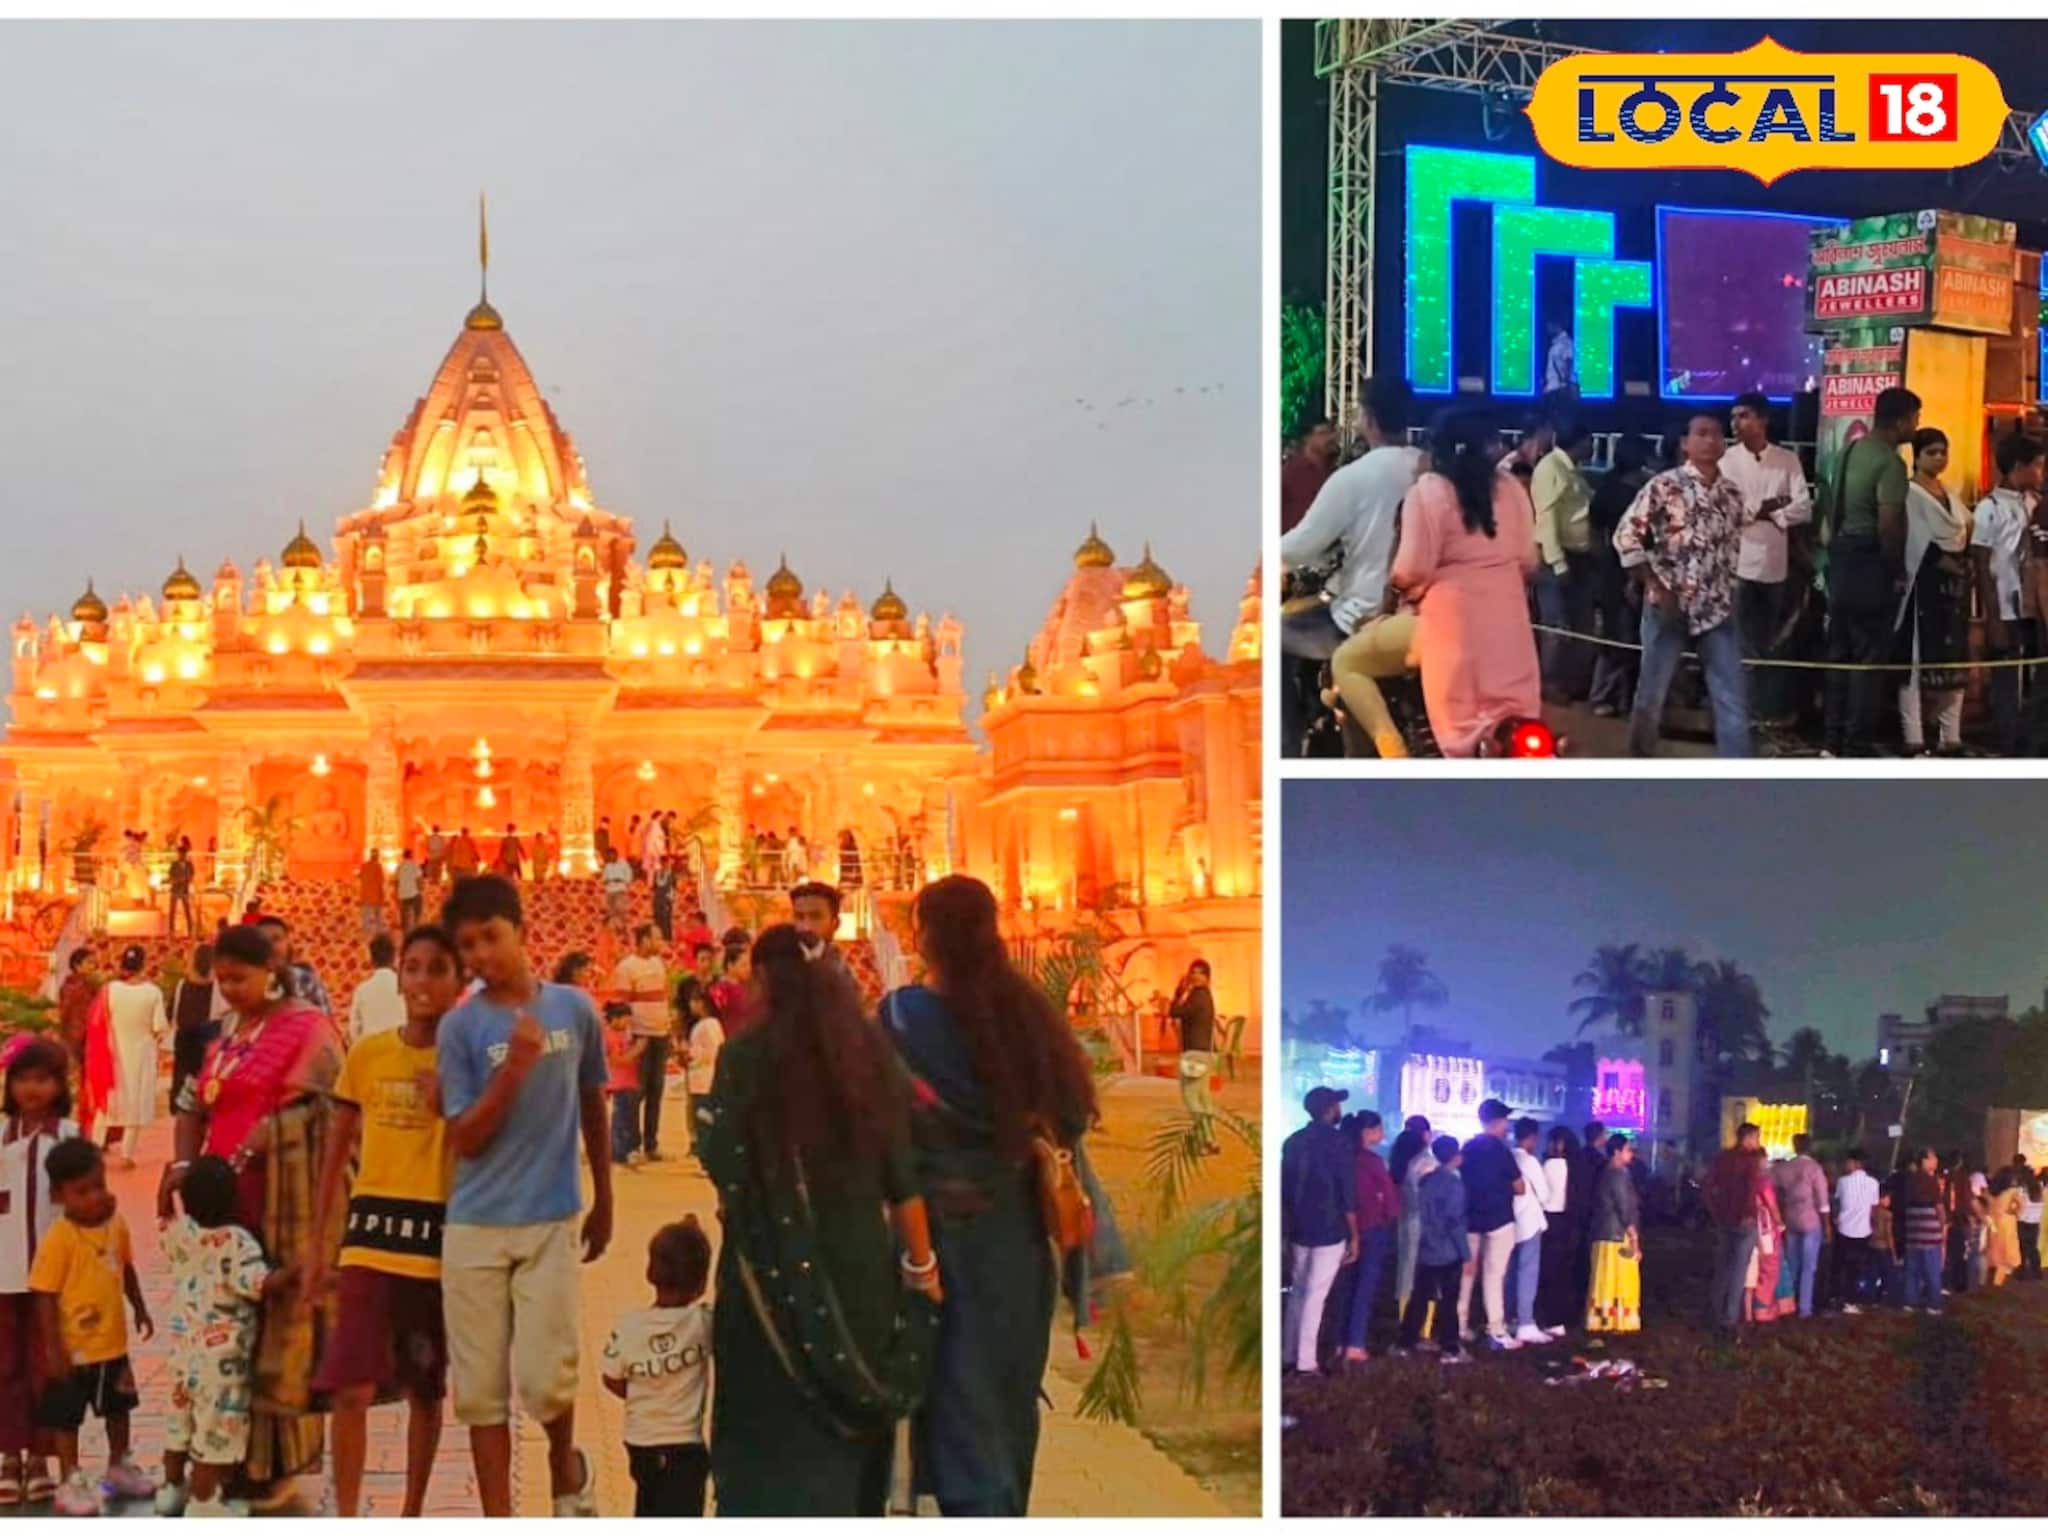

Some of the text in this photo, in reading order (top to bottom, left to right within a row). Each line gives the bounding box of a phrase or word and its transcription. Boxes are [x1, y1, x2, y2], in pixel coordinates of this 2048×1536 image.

[1820, 270, 1920, 299] ABINASH
[1943, 270, 2008, 298] ABINASH
[1820, 294, 1919, 313] JEWELLERS
